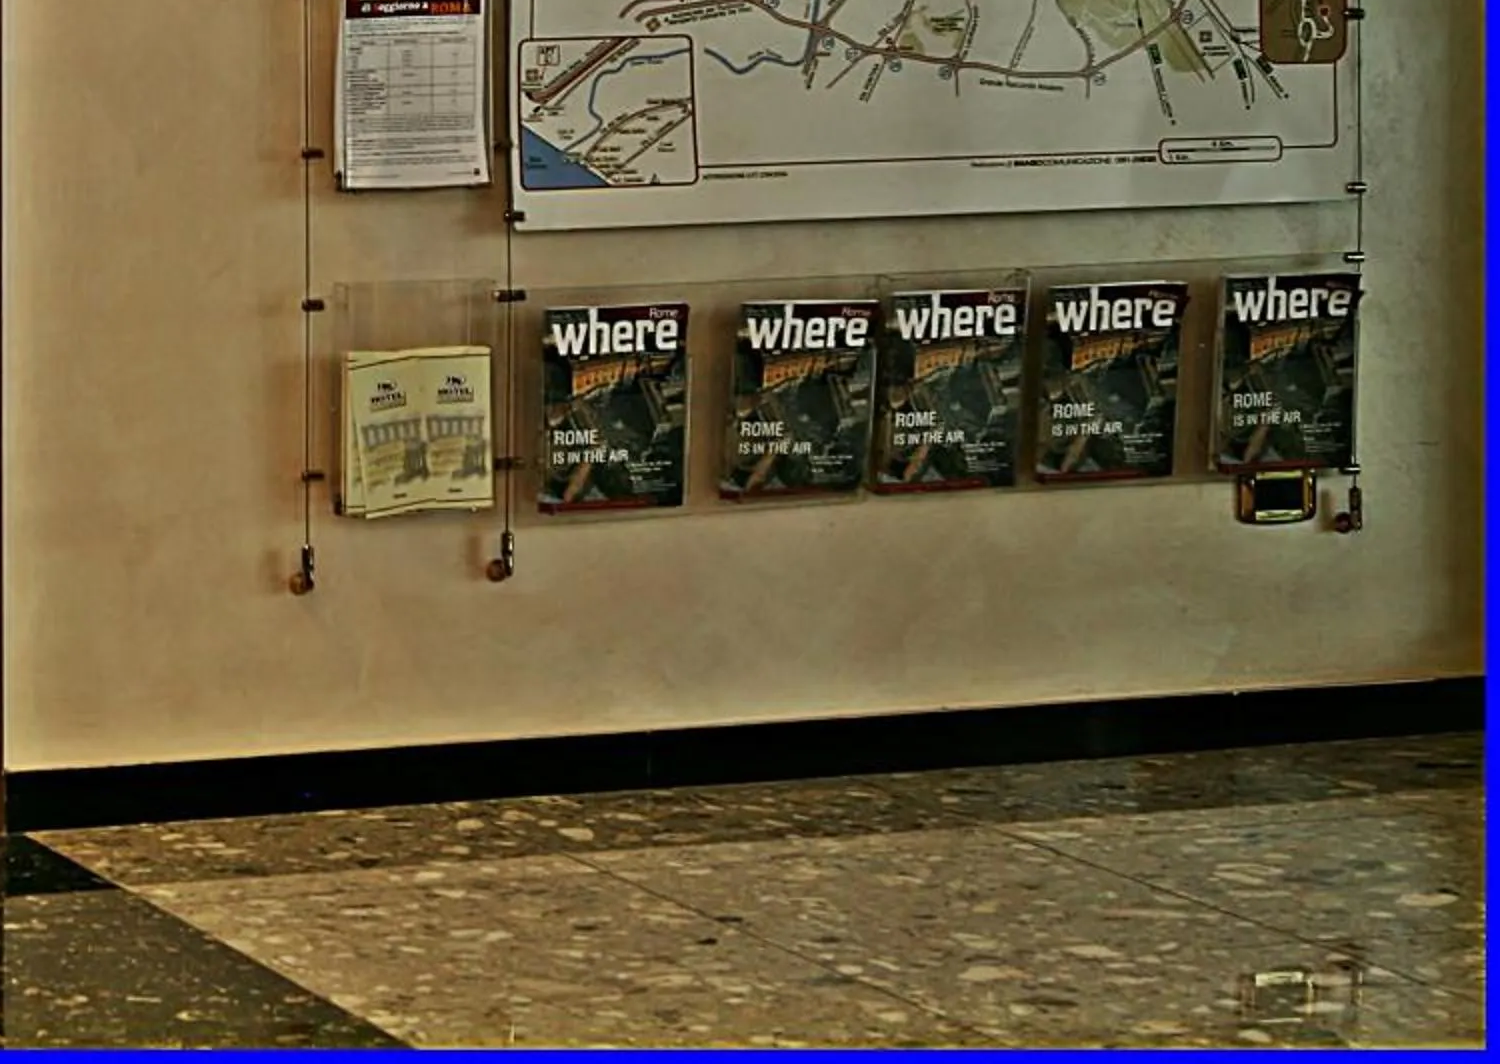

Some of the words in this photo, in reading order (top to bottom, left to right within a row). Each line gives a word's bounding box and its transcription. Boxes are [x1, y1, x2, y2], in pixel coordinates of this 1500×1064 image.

[1234, 276, 1351, 322] where
[649, 308, 679, 319] Rome
[897, 291, 1016, 340] where
[1055, 286, 1176, 332] where
[552, 308, 678, 356] where
[747, 304, 869, 348] where
[1233, 392, 1273, 408] ROME
[895, 411, 937, 427] ROME
[1053, 403, 1095, 419] ROME
[1233, 414, 1245, 426] IS
[1247, 413, 1258, 425] IN
[1260, 412, 1281, 425] THE
[1283, 411, 1301, 423] AIR
[740, 421, 785, 437] ROME
[1052, 424, 1063, 436] IS
[1066, 423, 1078, 435] IN
[1081, 422, 1101, 435] THE
[1104, 421, 1123, 434] AIR
[553, 429, 600, 445] ROME
[894, 434, 905, 445] IS
[908, 434, 919, 445] IN
[923, 431, 942, 444] THE
[945, 430, 964, 443] AIR
[738, 443, 751, 455] IS
[753, 443, 764, 454] IN
[768, 441, 788, 454] THE
[793, 441, 811, 453] AIR
[553, 451, 565, 465] IS
[567, 451, 581, 463] IN
[584, 449, 606, 463] THE
[609, 449, 629, 462] AIR
